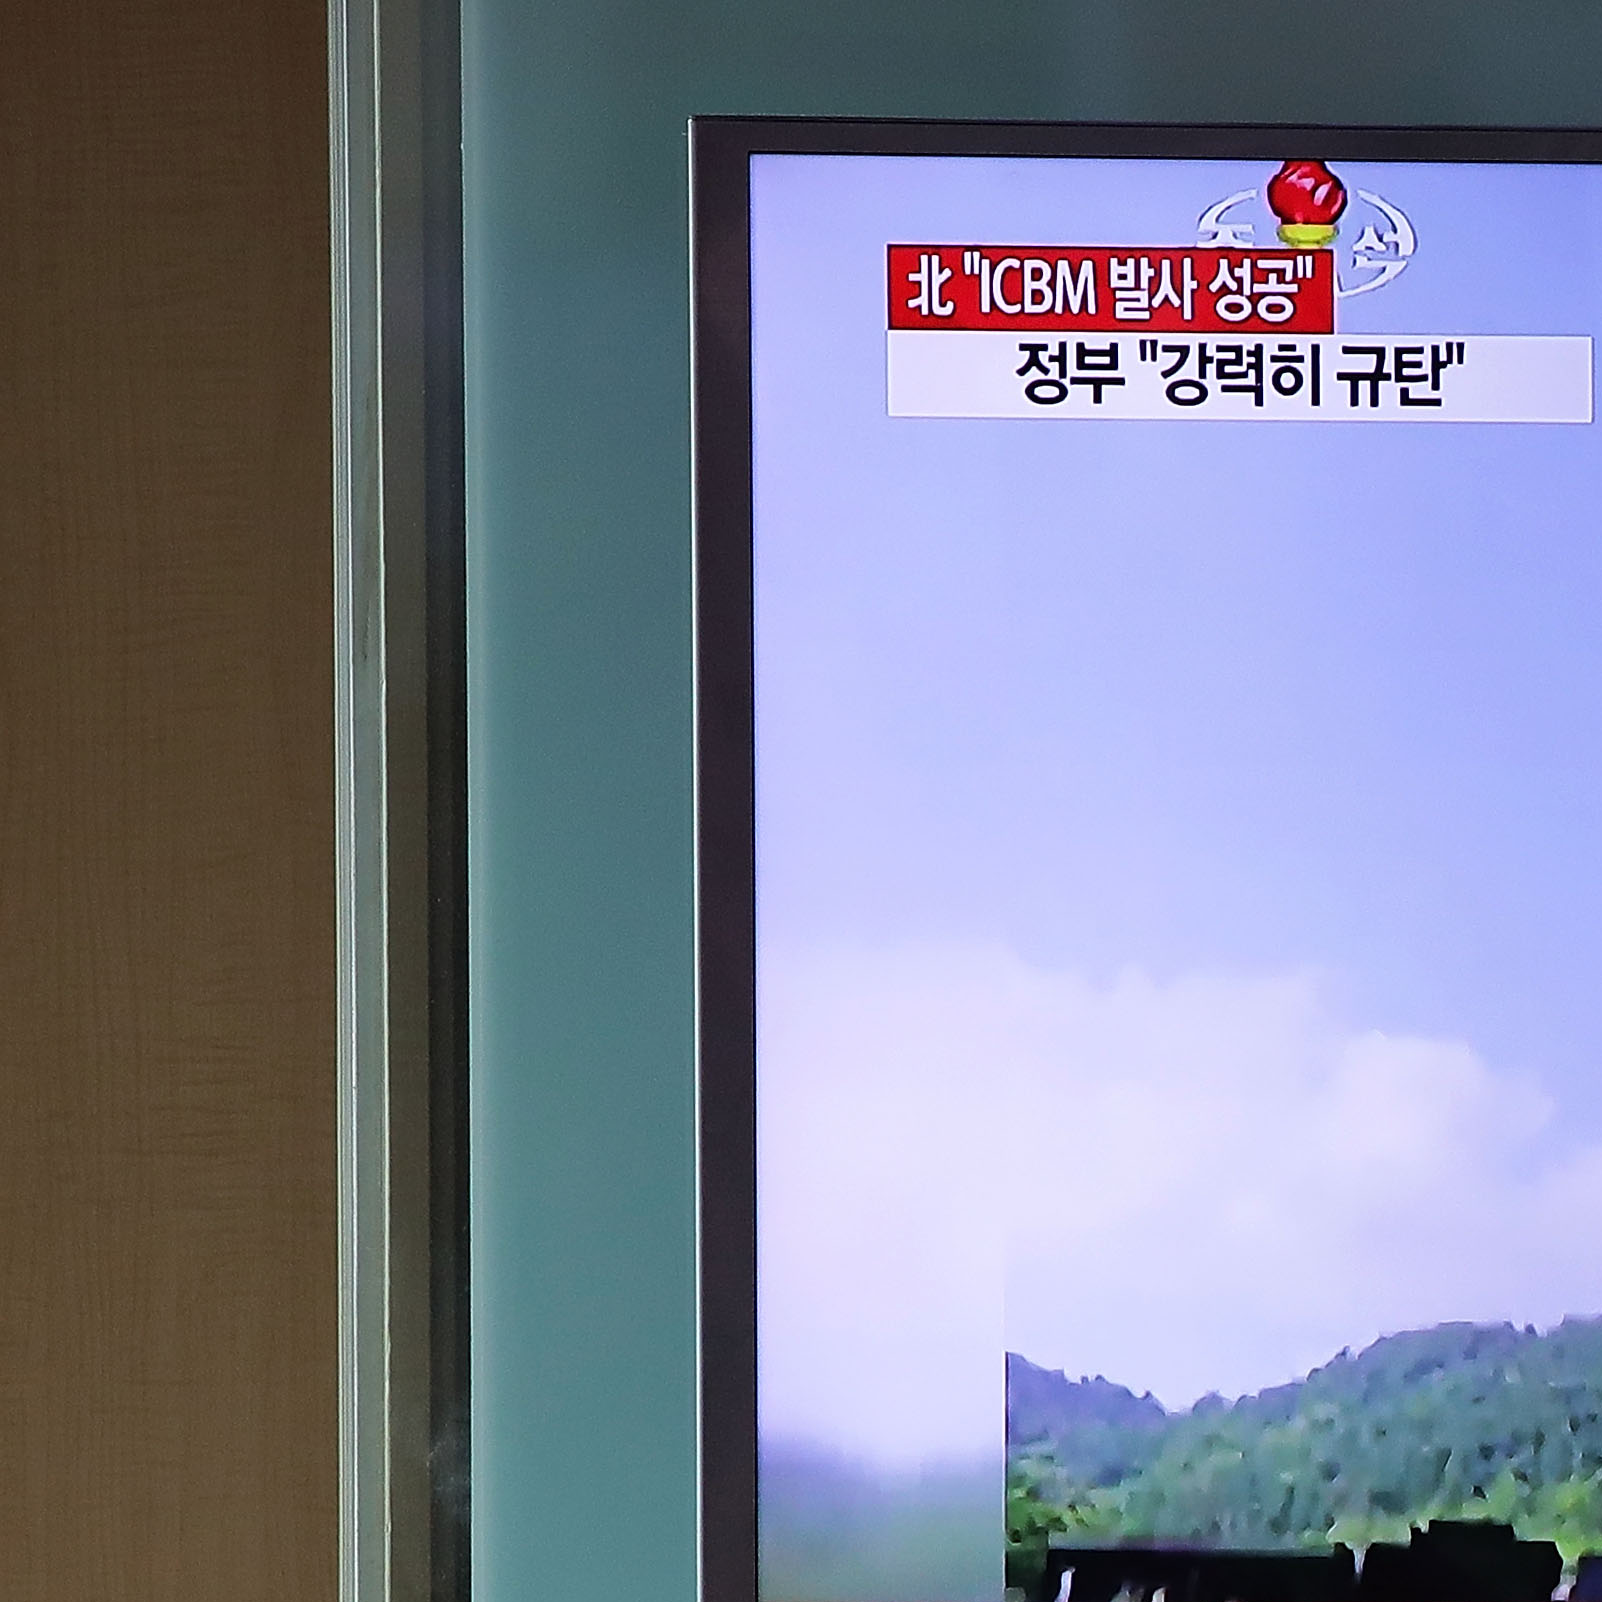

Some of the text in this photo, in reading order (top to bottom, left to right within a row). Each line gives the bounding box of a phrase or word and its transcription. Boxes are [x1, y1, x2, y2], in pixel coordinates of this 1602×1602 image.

[907, 249, 1314, 323] 北 "ICBM 발사 성공"
[1015, 338, 1467, 408] 정부 "강력히 규탄"
